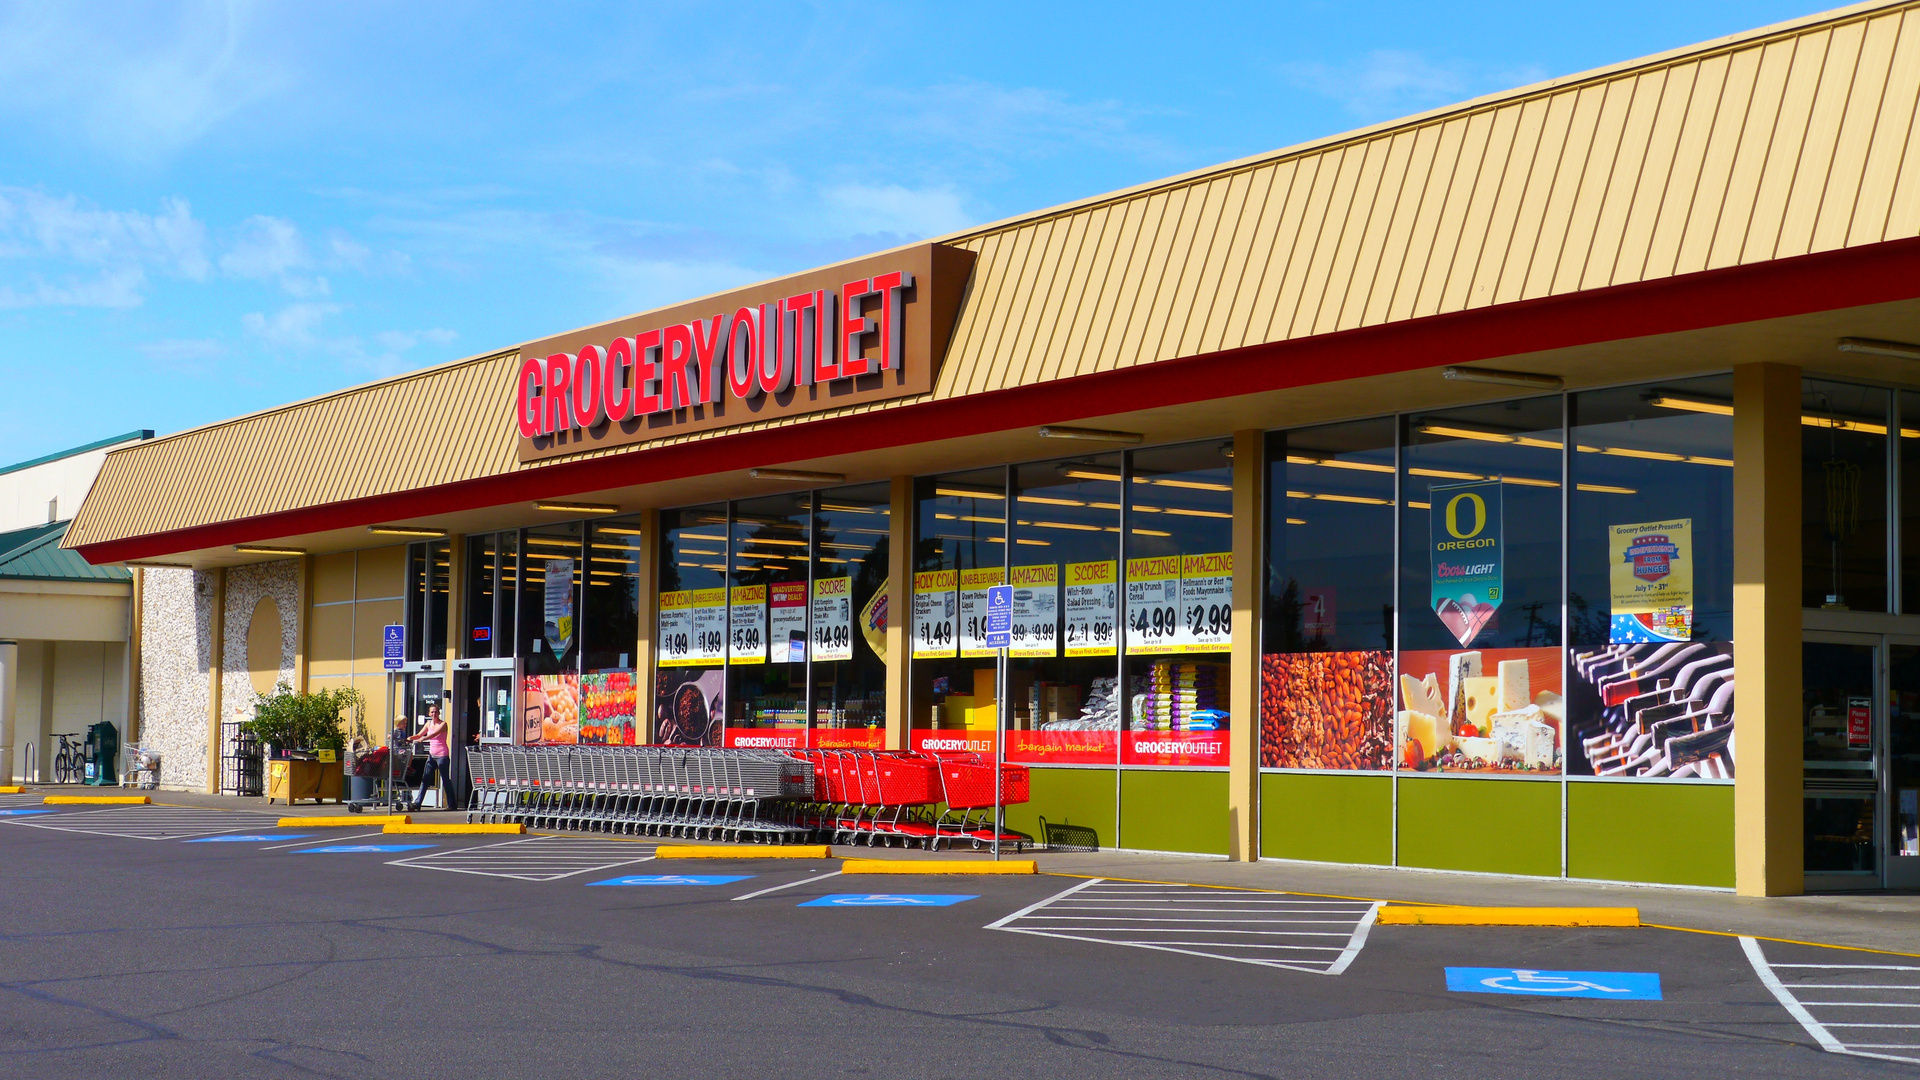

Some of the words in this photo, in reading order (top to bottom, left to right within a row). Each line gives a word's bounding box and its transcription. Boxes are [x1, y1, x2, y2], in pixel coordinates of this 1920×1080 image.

[1446, 493, 1486, 539] O
[1616, 525, 1639, 535] Grocery
[1639, 524, 1657, 533] Outlet
[1658, 521, 1684, 531] Presents
[1437, 538, 1496, 551] OREGON
[1630, 545, 1675, 556] INDEPENDENCE
[1012, 567, 1056, 584] AMAZING!
[1074, 563, 1110, 581] SCORE!
[1128, 558, 1179, 577] AMAZING!
[1637, 565, 1668, 575] HUNGER
[774, 584, 805, 593] UNADVERTISED
[819, 579, 846, 595] SCORE!
[914, 574, 935, 590] HOLY
[936, 571, 957, 587] COW!
[1144, 582, 1162, 590] Crunch
[1182, 578, 1207, 587] Hellmann's
[1213, 577, 1224, 585] Best
[732, 586, 766, 602] AMAZING!
[962, 592, 973, 600] Dawn
[1067, 587, 1093, 596] Wish-Bone
[1128, 592, 1144, 601] Cereal
[1182, 588, 1195, 596] Foods
[1196, 586, 1224, 596] Mayonnaise
[660, 593, 676, 607] HOLY
[962, 602, 973, 610] Liquid
[1067, 598, 1080, 607] Salad
[1081, 597, 1101, 607] Dressing
[1313, 595, 1326, 617] 4
[1130, 606, 1176, 638] $4.99
[1186, 603, 1232, 636] $2.99
[472, 629, 488, 639] OPEN
[815, 625, 848, 649] $14.99
[921, 620, 951, 645] $1.49
[1032, 623, 1054, 641] $9.99
[1067, 623, 1075, 643] 2
[1081, 622, 1088, 642] $1
[1094, 621, 1113, 641] 99¢
[665, 633, 688, 655] $1.99
[698, 631, 721, 652] $1.99
[733, 628, 759, 651] $5.99
[1018, 739, 1062, 755] bargain
[1065, 743, 1104, 752] market
